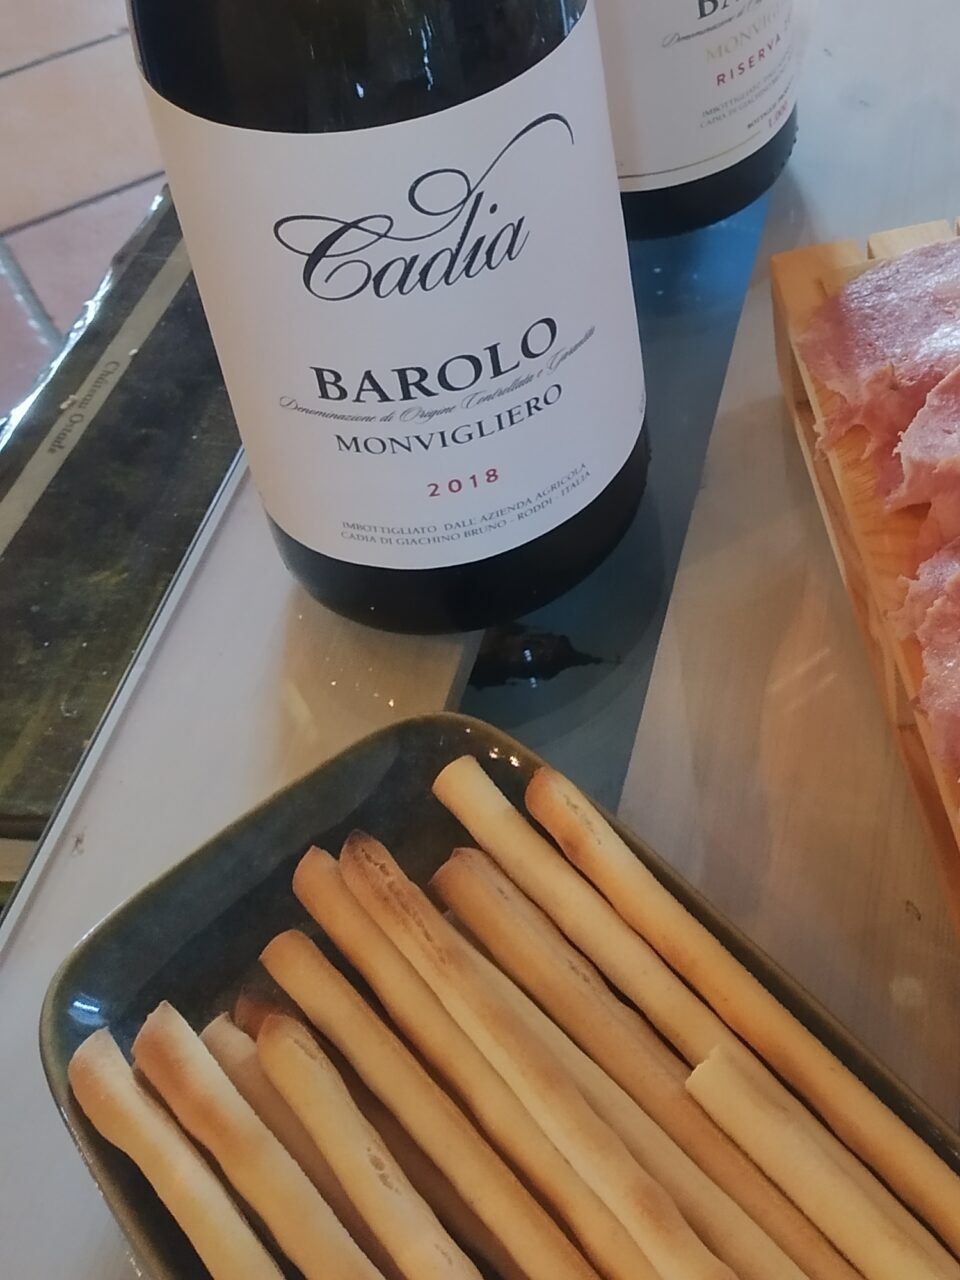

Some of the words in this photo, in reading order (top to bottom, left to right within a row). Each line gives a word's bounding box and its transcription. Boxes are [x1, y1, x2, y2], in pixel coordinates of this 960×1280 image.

[716, 33, 781, 87] RISERVA
[273, 112, 575, 301] Cadia
[309, 316, 557, 403] BAROLO
[280, 395, 376, 422] Denominazione
[379, 411, 395, 423] di
[399, 406, 457, 424] Origine
[335, 383, 562, 455] MONVIGLIERO
[340, 531, 377, 544] CADIA
[396, 532, 461, 546] GIACHINO
[464, 519, 507, 538] BRUNO
[517, 497, 553, 521] RODDI
[561, 471, 591, 497] ITALIA
[342, 521, 437, 535] IMBOTTIGLIATO
[480, 498, 533, 523] AZIENDA
[535, 463, 586, 501] AGRICOLA
[427, 468, 499, 498] 2018
